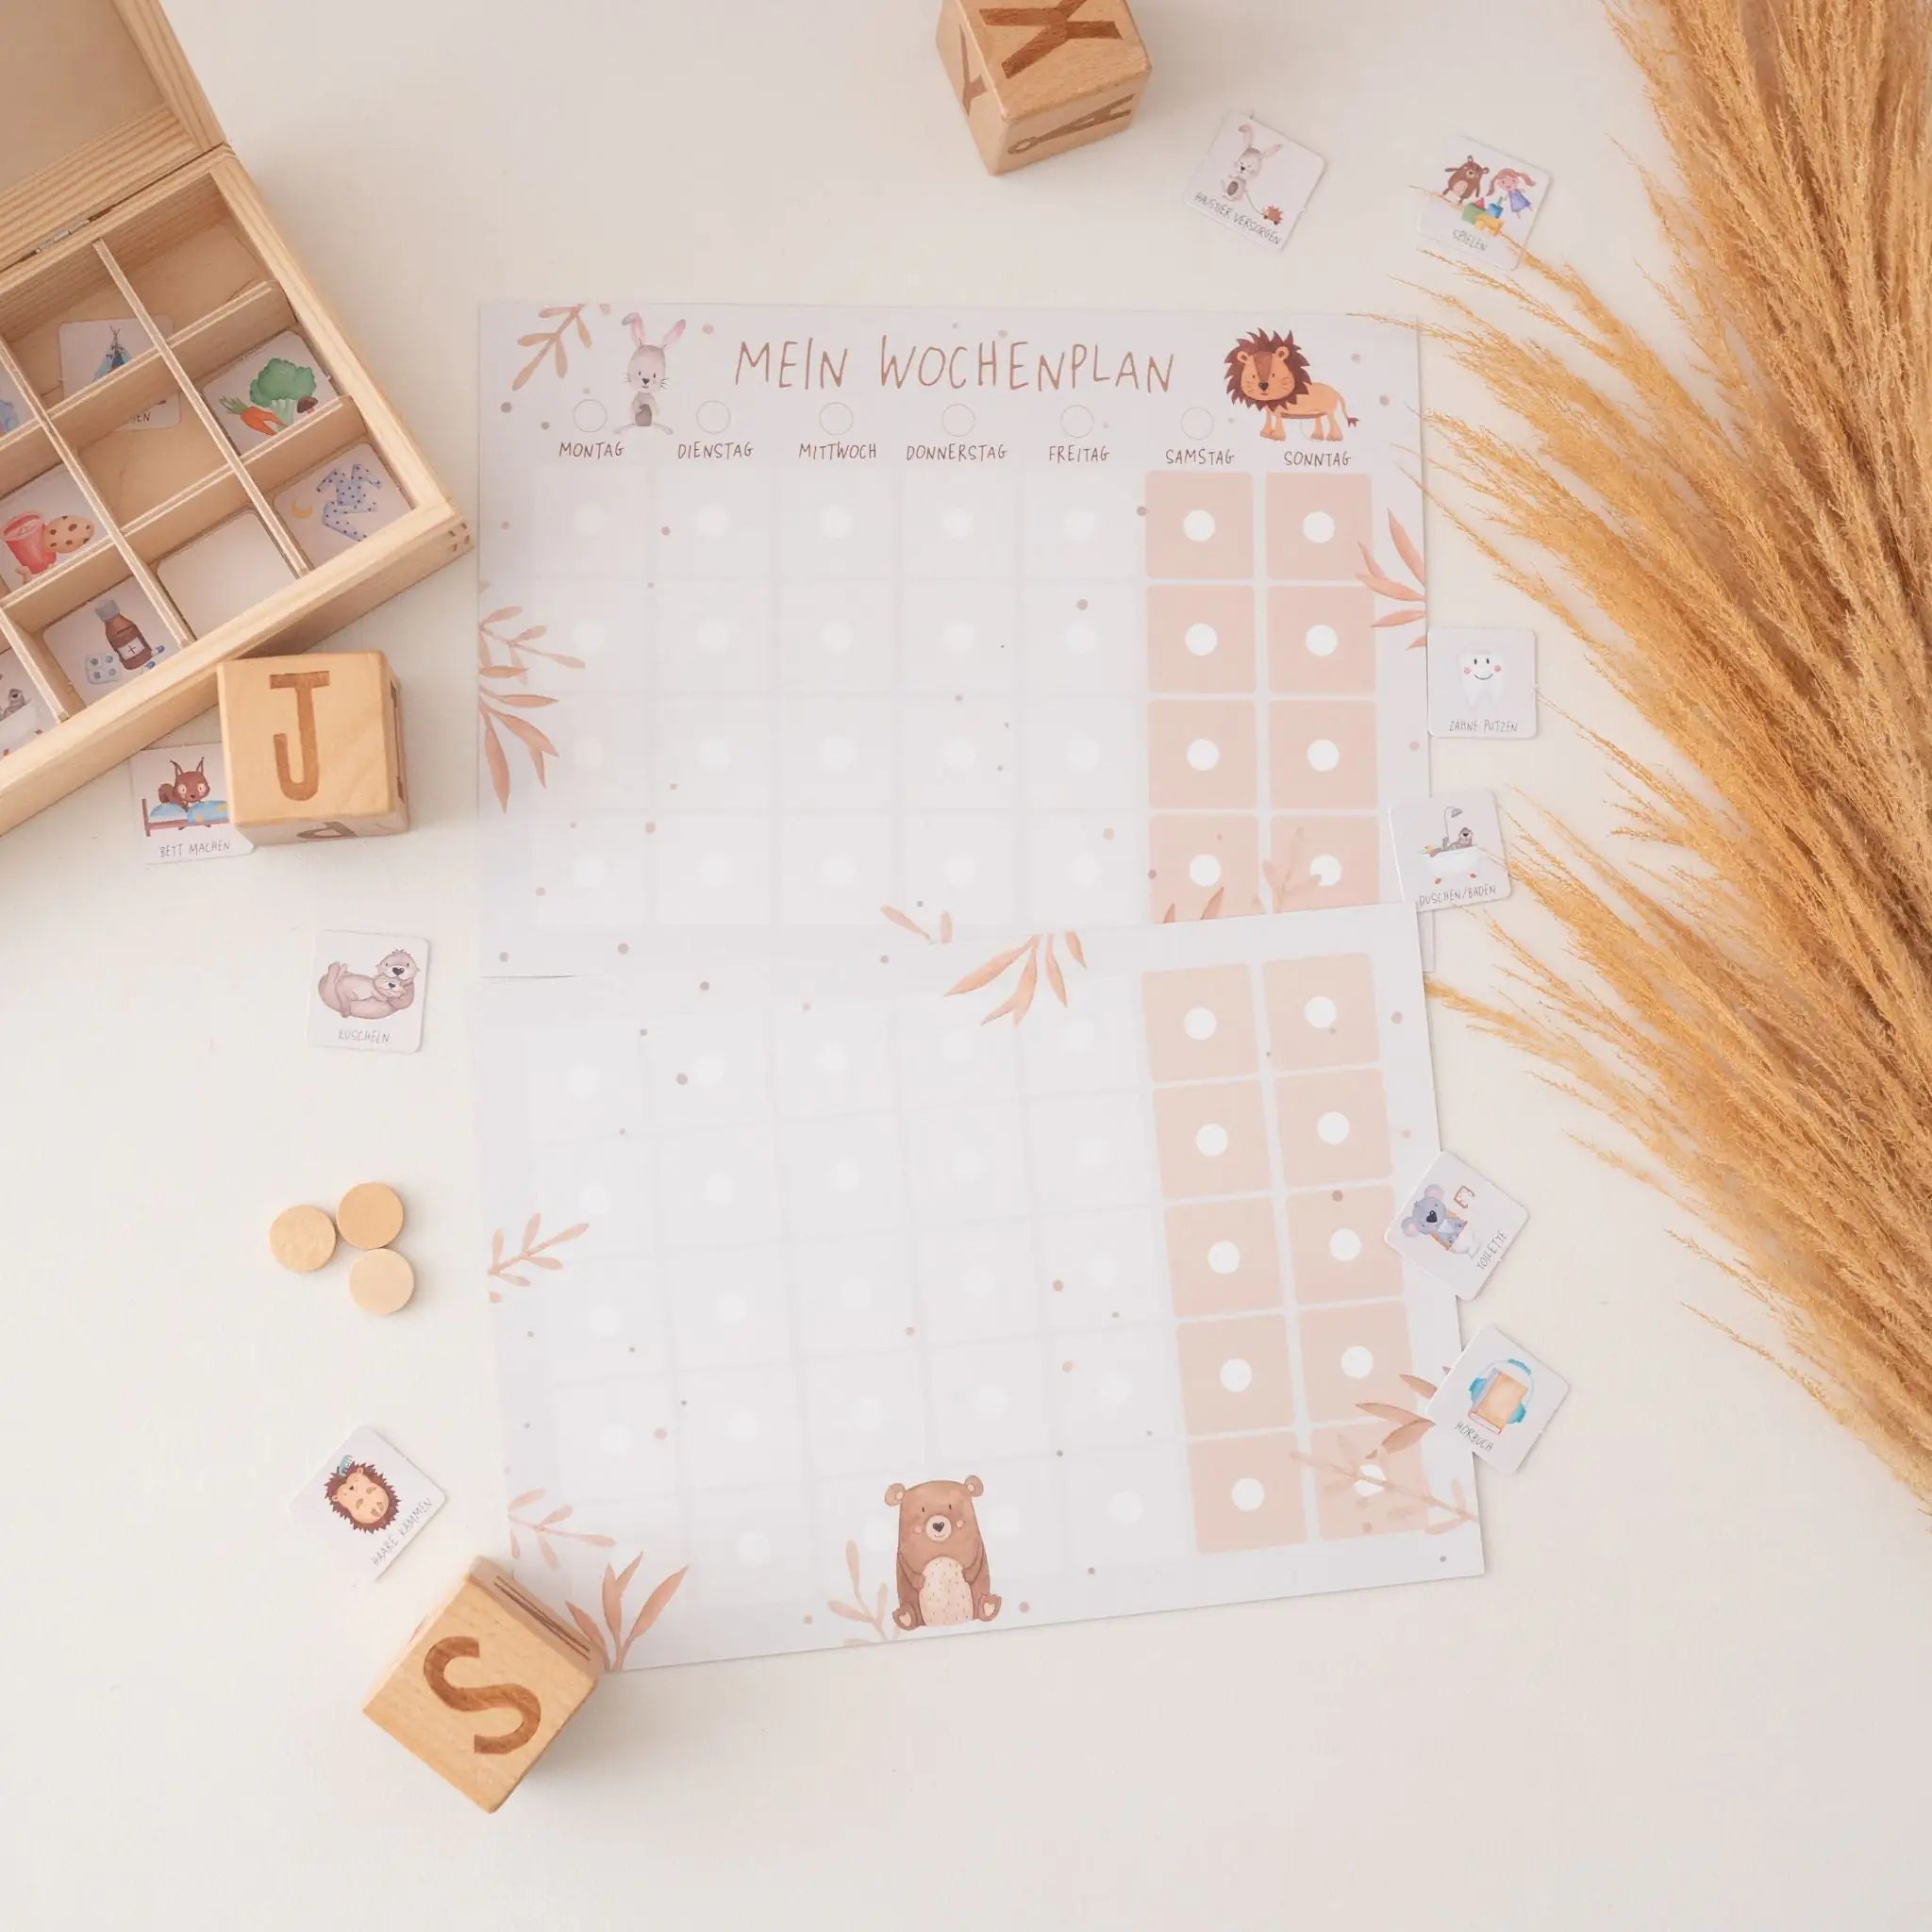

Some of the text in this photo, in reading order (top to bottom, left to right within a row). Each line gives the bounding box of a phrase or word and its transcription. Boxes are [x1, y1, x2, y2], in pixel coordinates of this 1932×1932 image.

[1194, 191, 1282, 245] HAUSTIER VERSORGEN
[735, 334, 1174, 393] MEIN WOCHENPLAN
[558, 441, 625, 460] MONTAG
[677, 441, 755, 460] DIENSTAG
[798, 441, 877, 461] MITTWOCH
[906, 442, 1008, 462] DONNERSTAG
[1048, 444, 1110, 464] FREITAG
[1164, 448, 1236, 466] SAMSTAG
[1283, 450, 1352, 468] SONNTAG
[269, 670, 330, 802] J
[1483, 719, 1519, 733] PUTZEN
[158, 839, 231, 858] BETT MACHEN
[339, 1027, 391, 1044] KUSCHELN
[1476, 1229, 1507, 1270] TOILETTE
[370, 1534, 399, 1566] HAARE
[423, 1635, 542, 1756] S
